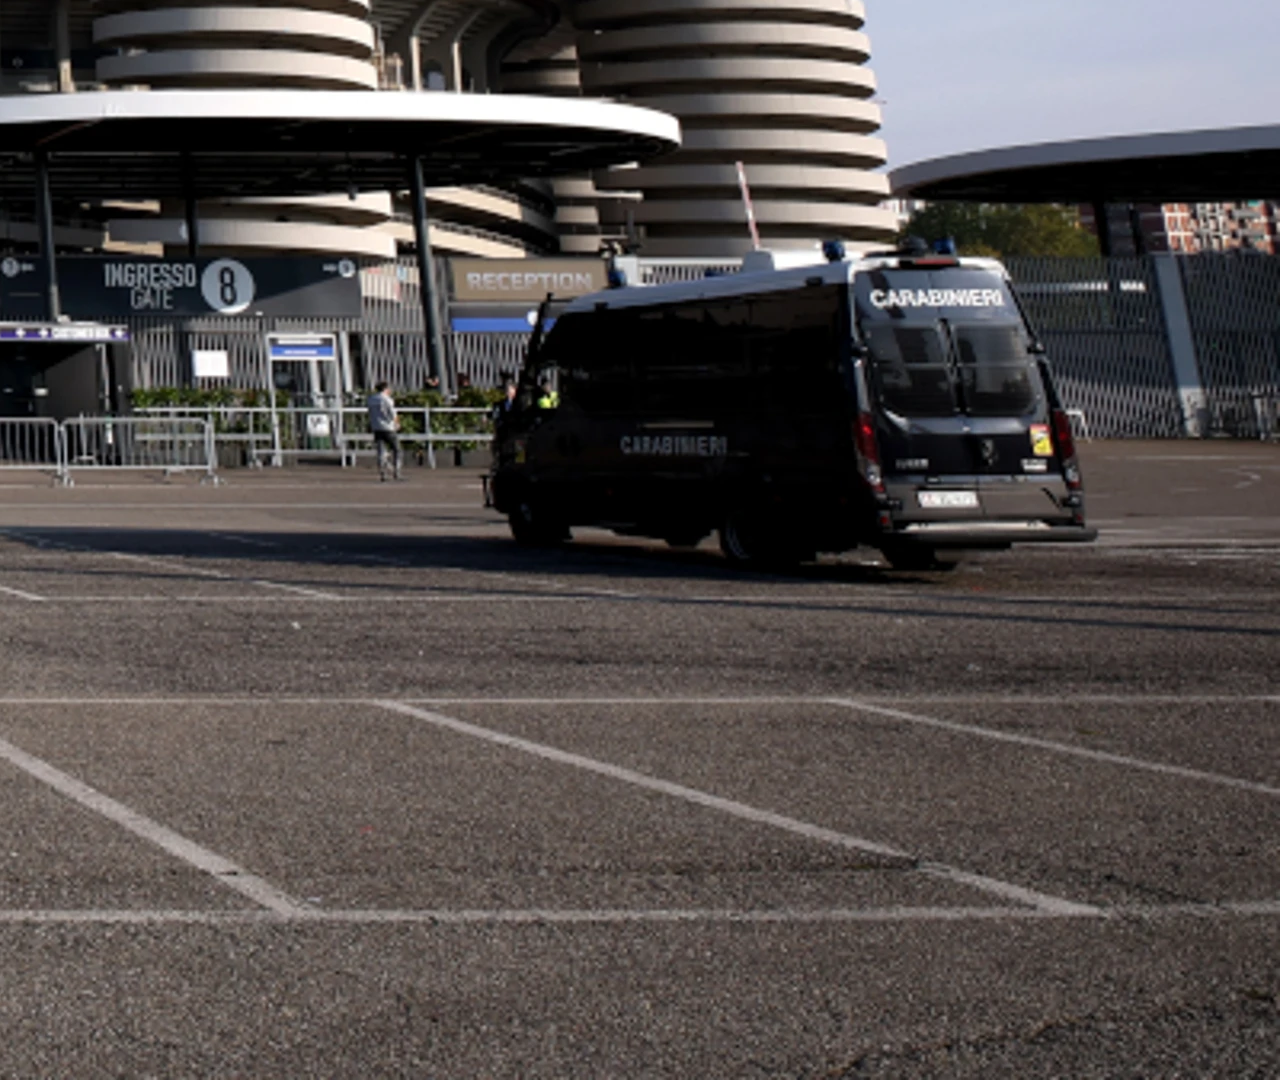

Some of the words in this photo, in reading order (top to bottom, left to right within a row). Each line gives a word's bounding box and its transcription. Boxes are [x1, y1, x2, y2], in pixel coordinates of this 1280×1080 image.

[104, 263, 197, 288] INGRESSO
[220, 266, 237, 306] 8
[466, 272, 593, 291] RECEPTION
[130, 287, 174, 310] GATE
[870, 288, 1005, 307] CARABINIERI
[620, 435, 728, 456] CARABINIERI
